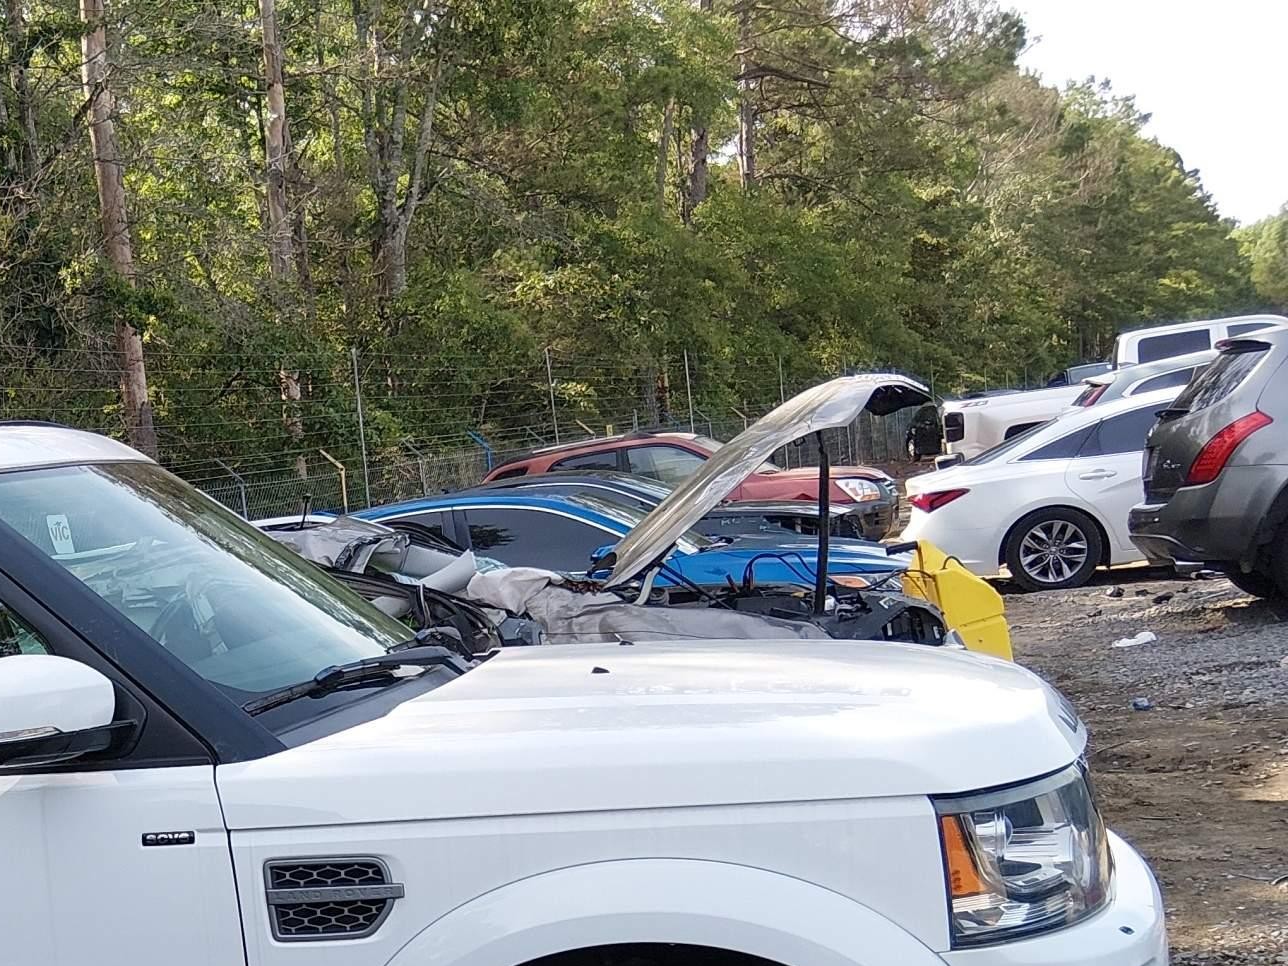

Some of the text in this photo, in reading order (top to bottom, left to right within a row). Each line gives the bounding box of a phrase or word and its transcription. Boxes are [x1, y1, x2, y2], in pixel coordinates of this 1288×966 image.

[51, 525, 70, 542] VIC
[273, 886, 394, 902] LAND ROVER
